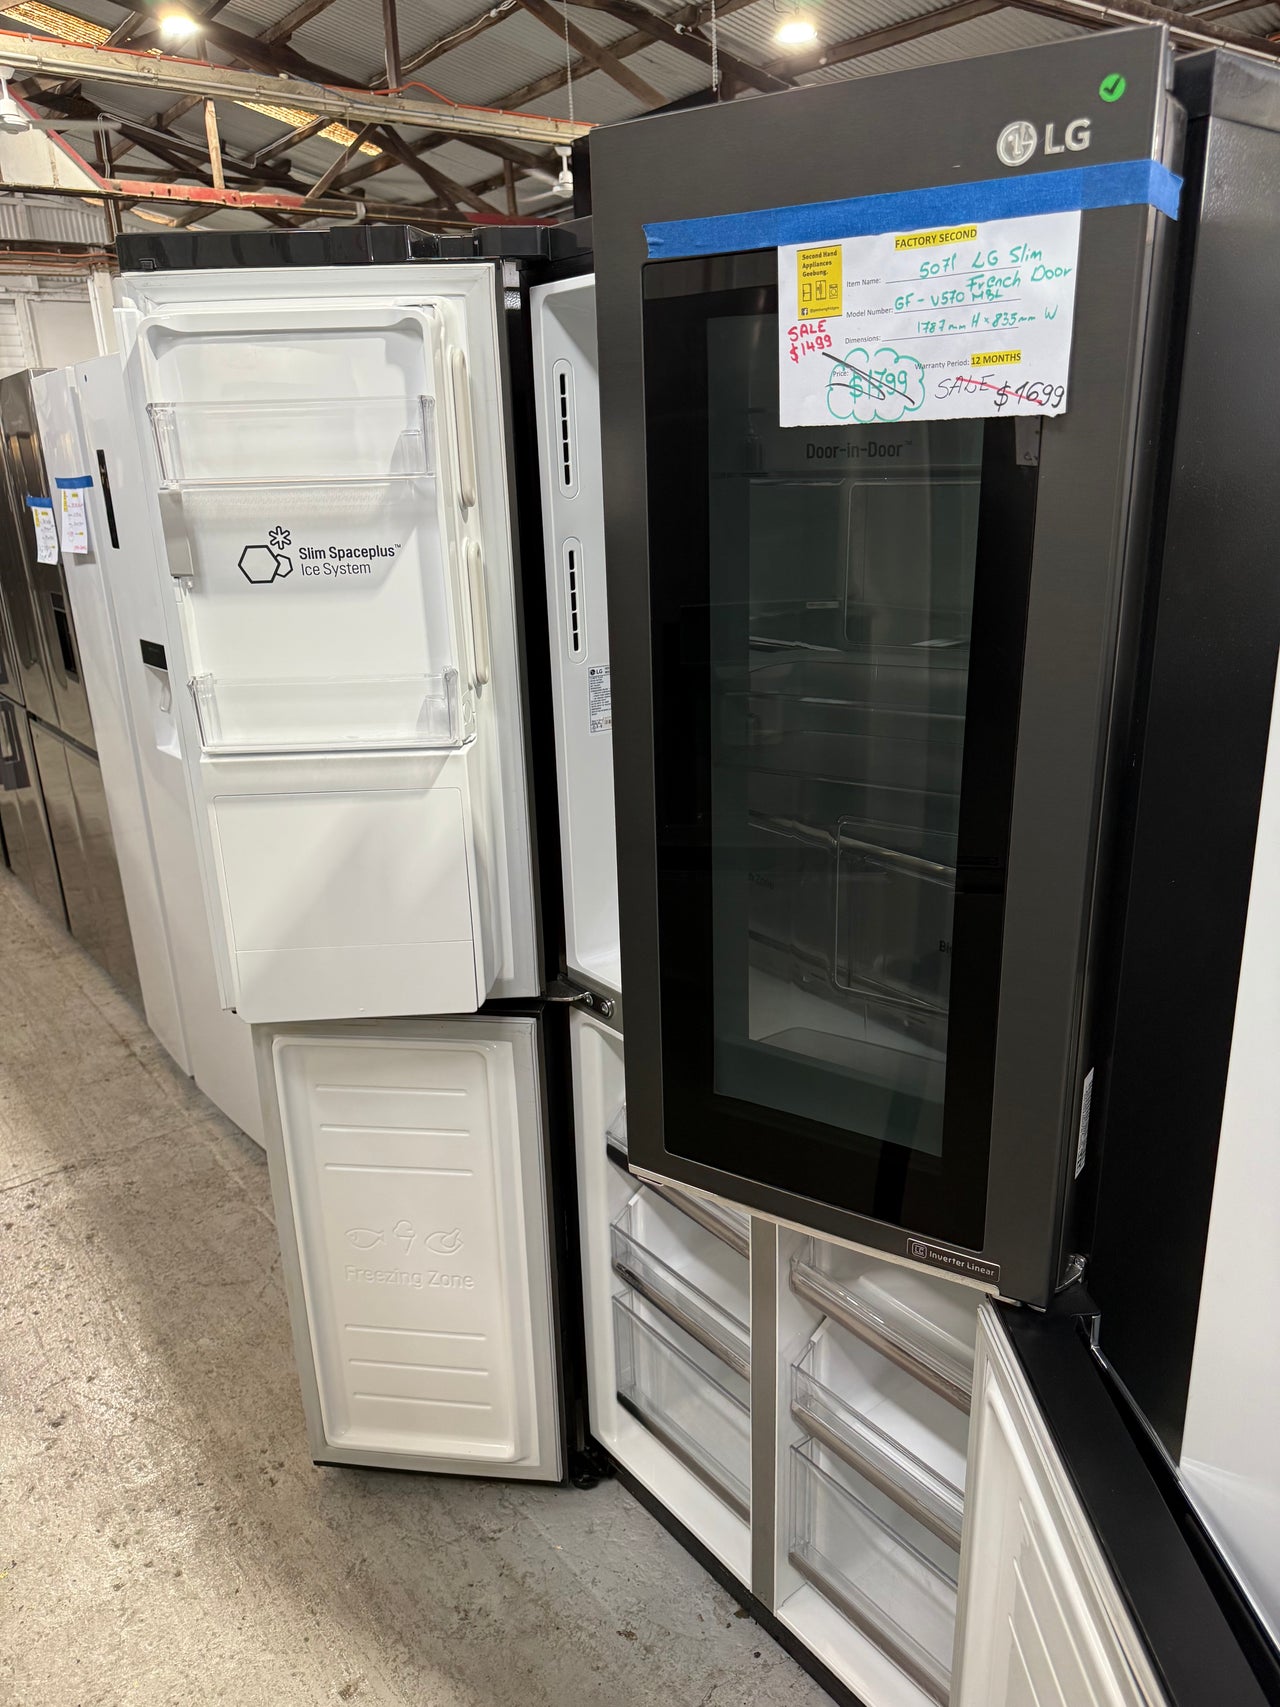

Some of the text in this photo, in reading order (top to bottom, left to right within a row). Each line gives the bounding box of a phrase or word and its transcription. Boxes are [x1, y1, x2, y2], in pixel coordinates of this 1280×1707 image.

[1044, 117, 1092, 155] LG
[895, 228, 978, 249] FACTORY SECOND
[802, 250, 838, 261] Second Hand
[802, 260, 832, 269] Appliances
[971, 250, 999, 269] LG
[1009, 243, 1042, 263] Slim
[846, 278, 881, 288] Item Name:
[966, 264, 1072, 291] French Door
[846, 309, 867, 318] Model
[866, 307, 894, 316] Number:
[1045, 305, 1058, 320] W
[788, 320, 827, 342] SALE
[789, 335, 832, 364] $1499
[845, 336, 881, 345] Dimensions:
[915, 352, 1021, 370] Warranty Period: 12 MONTHS
[832, 370, 849, 378] Price:
[935, 374, 1065, 412] SALE $1699
[299, 547, 326, 560] Slim
[301, 562, 371, 578] Ice System
[929, 1250, 965, 1267] Inverter
[967, 1262, 995, 1276] Linear
[344, 1265, 475, 1290] Freezing Zone
